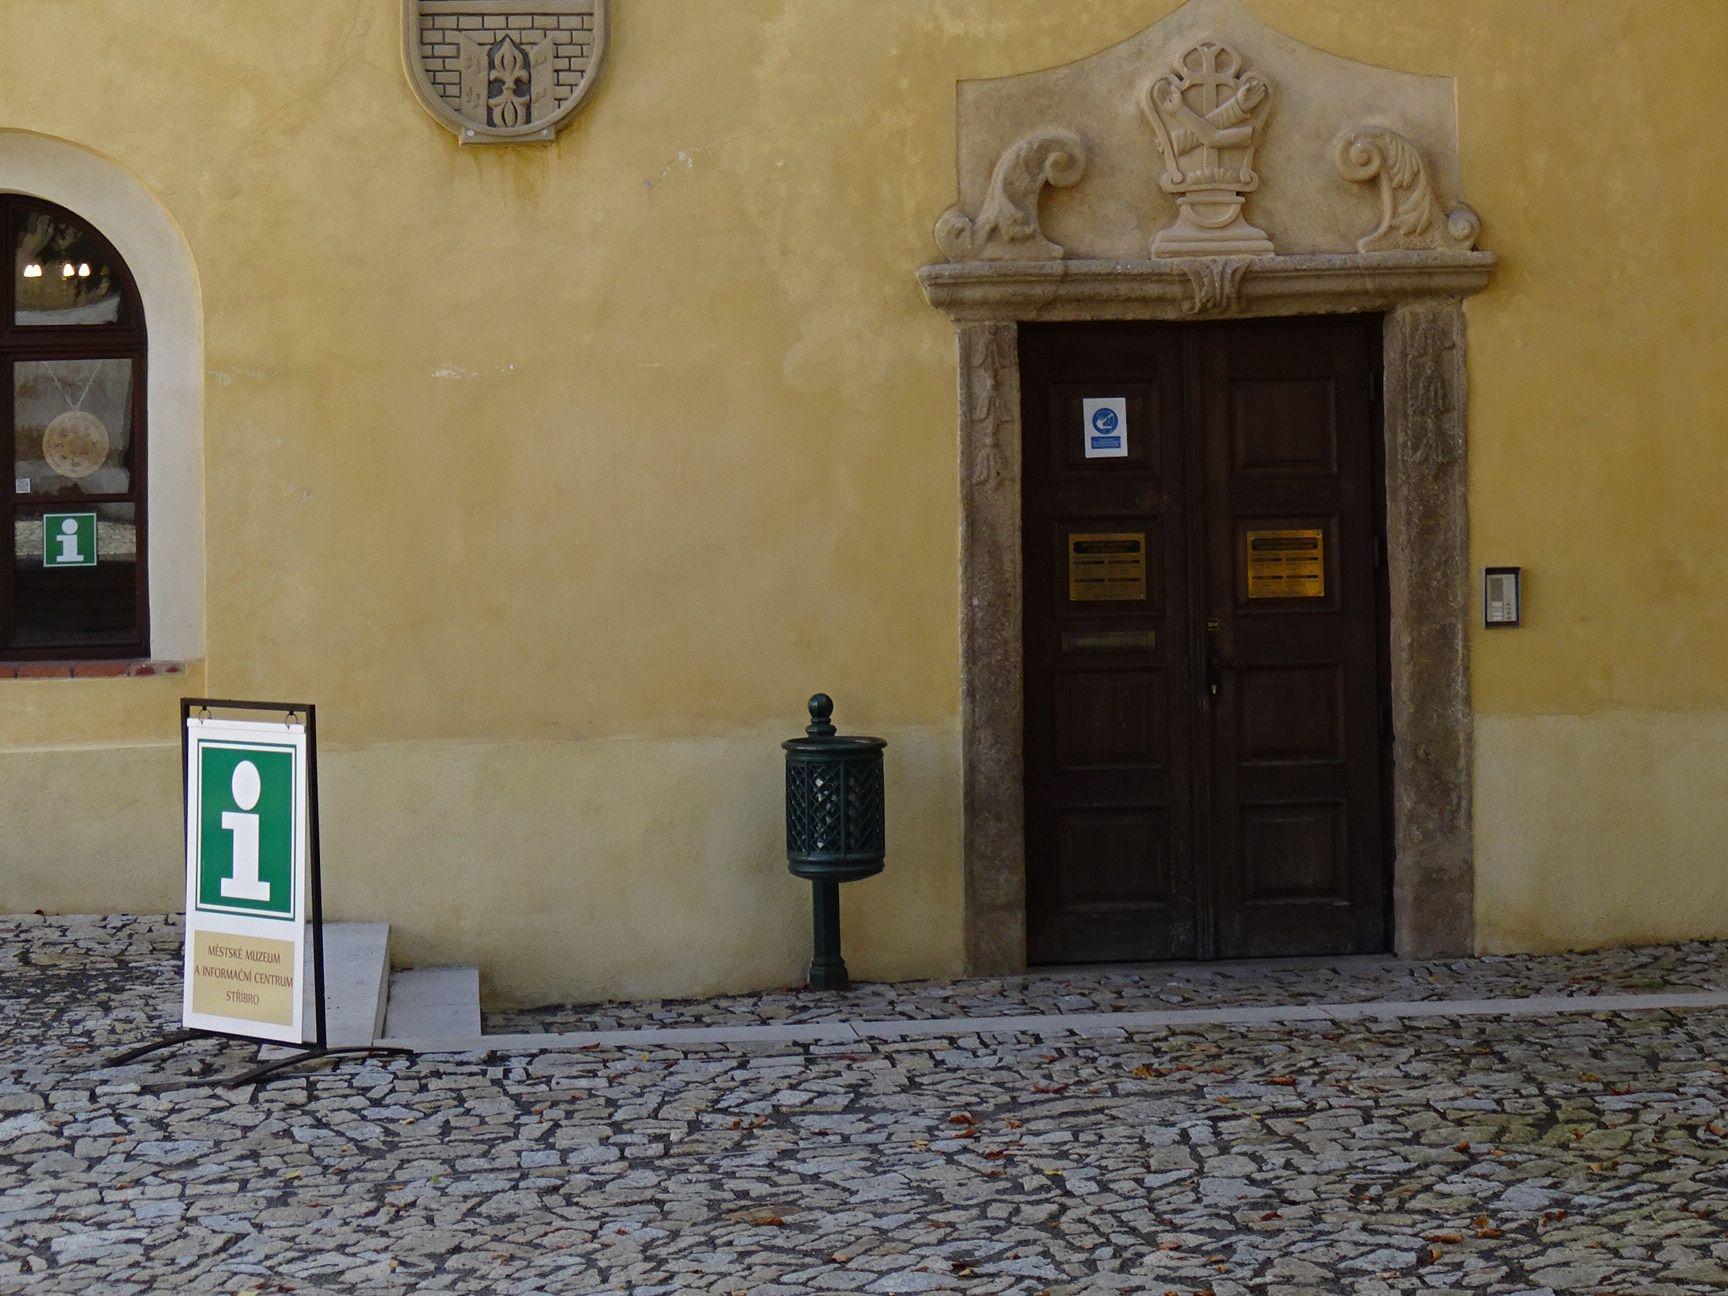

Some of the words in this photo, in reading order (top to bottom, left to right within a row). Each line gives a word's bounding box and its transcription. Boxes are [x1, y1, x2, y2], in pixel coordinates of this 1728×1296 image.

[245, 949, 281, 965] MUZEUM
[194, 965, 201, 976] A
[202, 965, 252, 982] INFORMAČNÍ
[253, 972, 293, 988] CENTRUM
